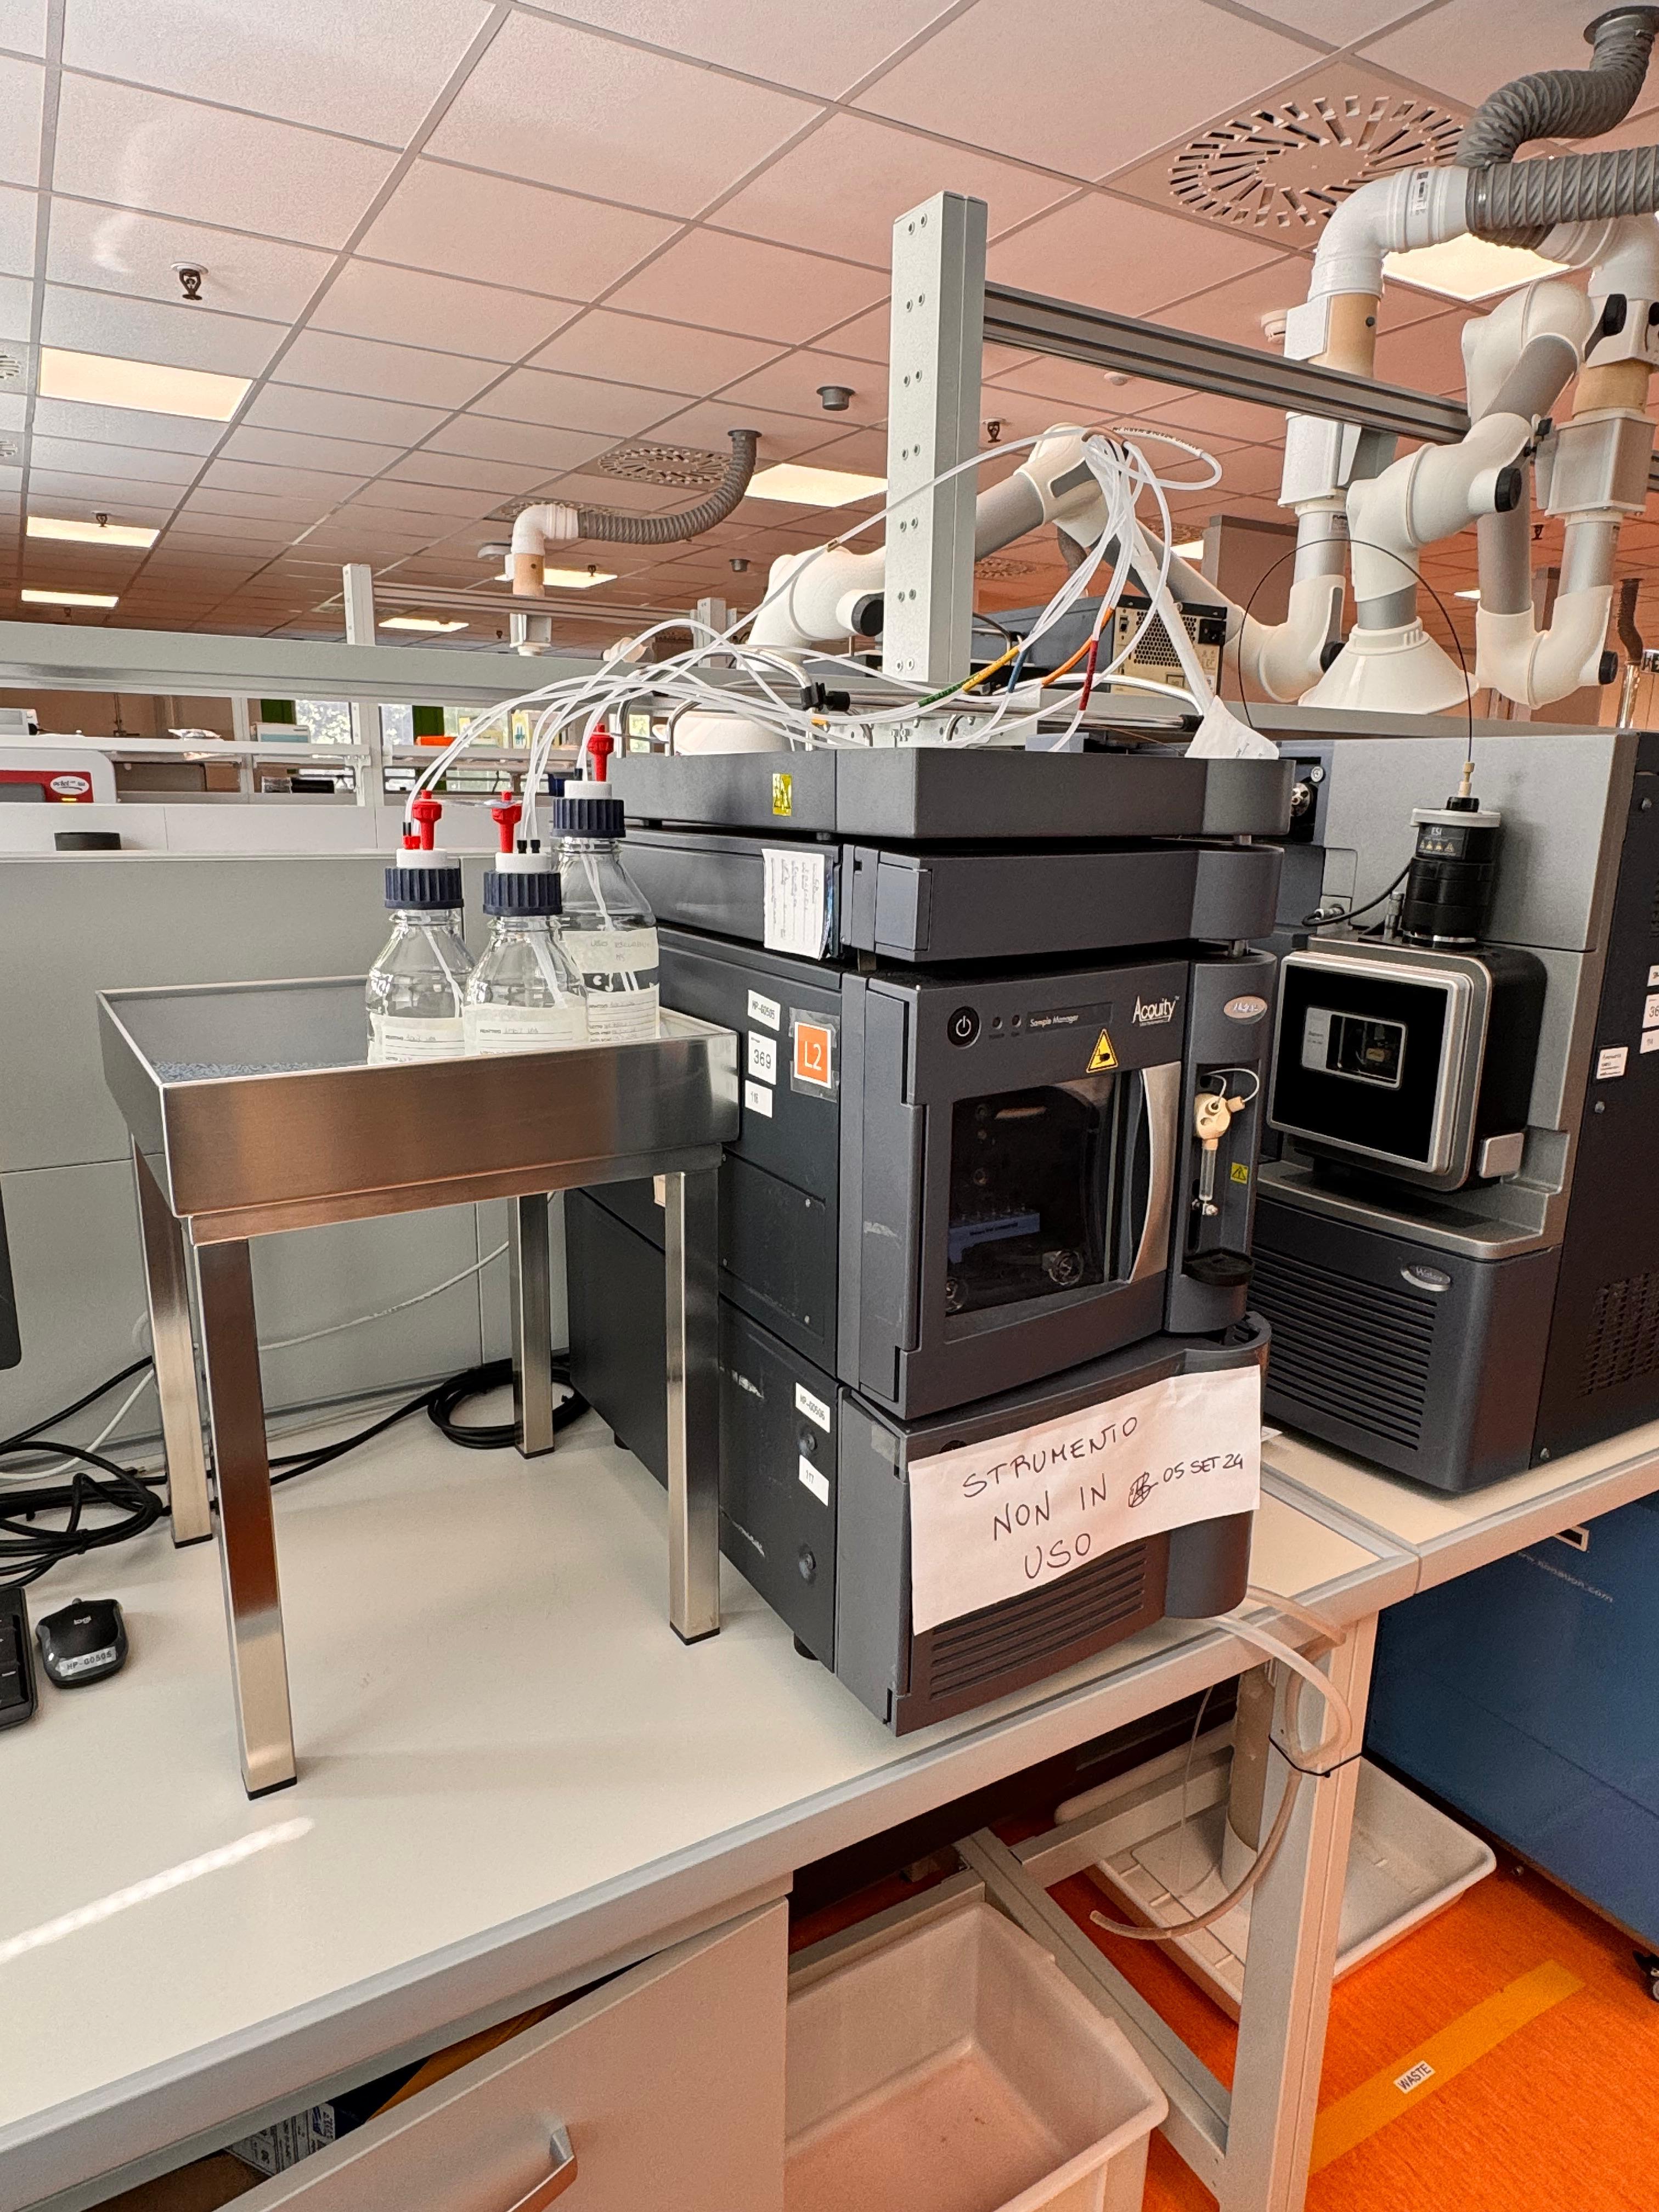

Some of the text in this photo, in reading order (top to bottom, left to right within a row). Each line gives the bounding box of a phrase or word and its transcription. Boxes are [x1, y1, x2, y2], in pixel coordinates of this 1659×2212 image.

[754, 1048, 771, 1069] 369
[804, 1041, 822, 1070] L2
[963, 1416, 1137, 1498] STRUMENTO
[1163, 1453, 1244, 1483] 05 SET 24
[994, 1490, 1050, 1541] NON
[1080, 1473, 1107, 1511] IN
[1024, 1533, 1092, 1579] USO
[1397, 2063, 1432, 2090] WASTE
